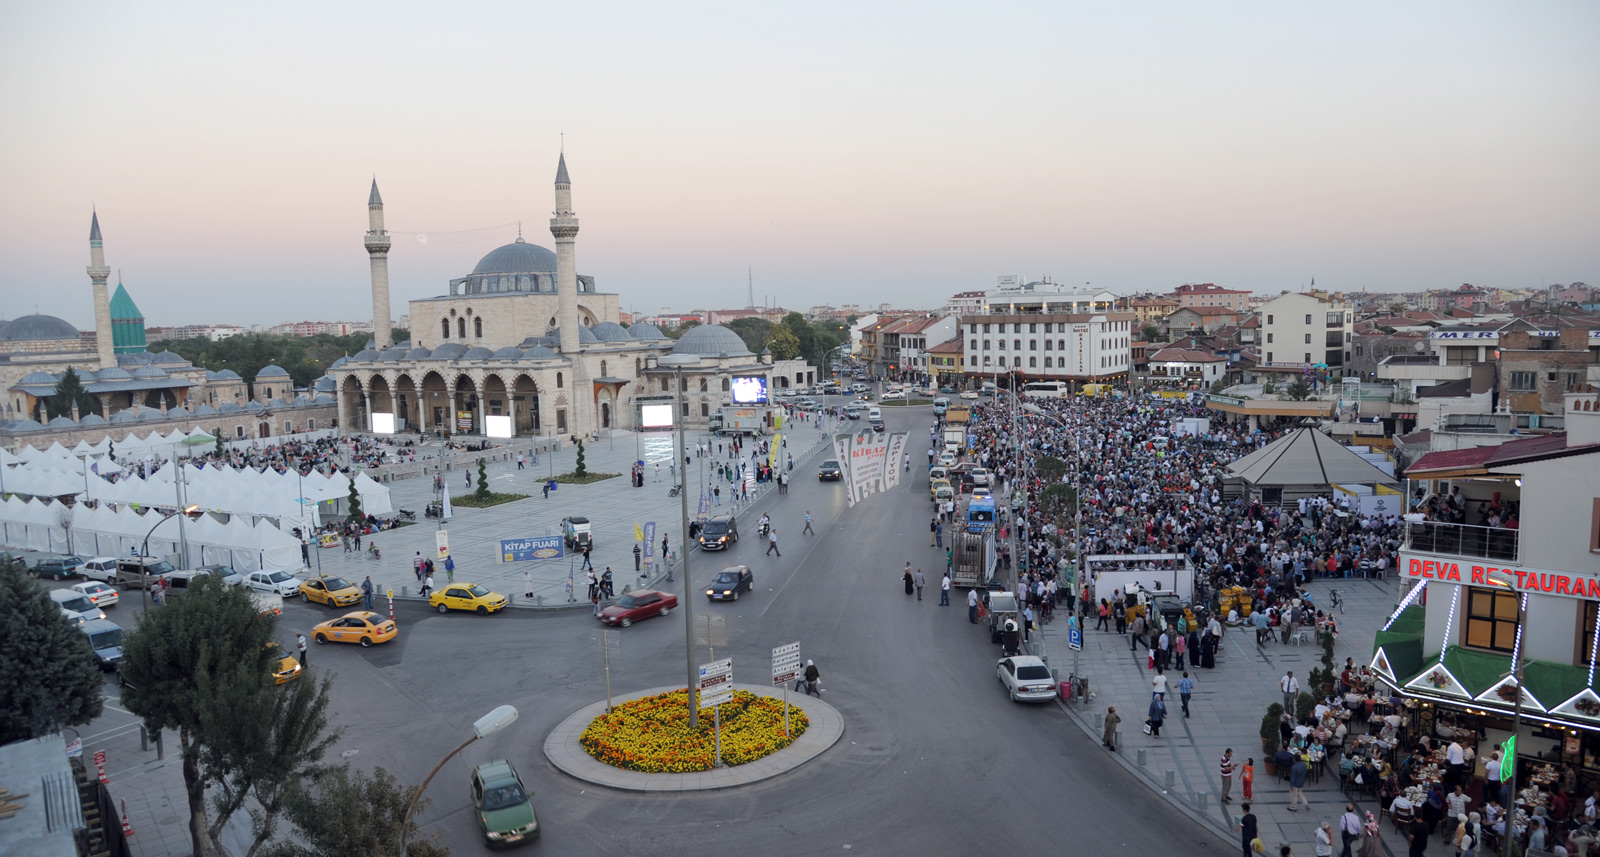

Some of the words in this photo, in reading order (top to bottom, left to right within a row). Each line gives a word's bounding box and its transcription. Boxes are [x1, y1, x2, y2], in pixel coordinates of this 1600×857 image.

[1439, 331, 1500, 339] MER
[852, 446, 886, 459] KİRAZ
[867, 453, 885, 461] grup
[504, 541, 531, 551] KİTAP
[532, 540, 559, 549] FUARI
[1409, 558, 1461, 581] DEVA
[1071, 630, 1078, 642] P
[774, 645, 794, 655] Adana
[773, 655, 795, 664] Karaman
[774, 664, 795, 674] Antalya
